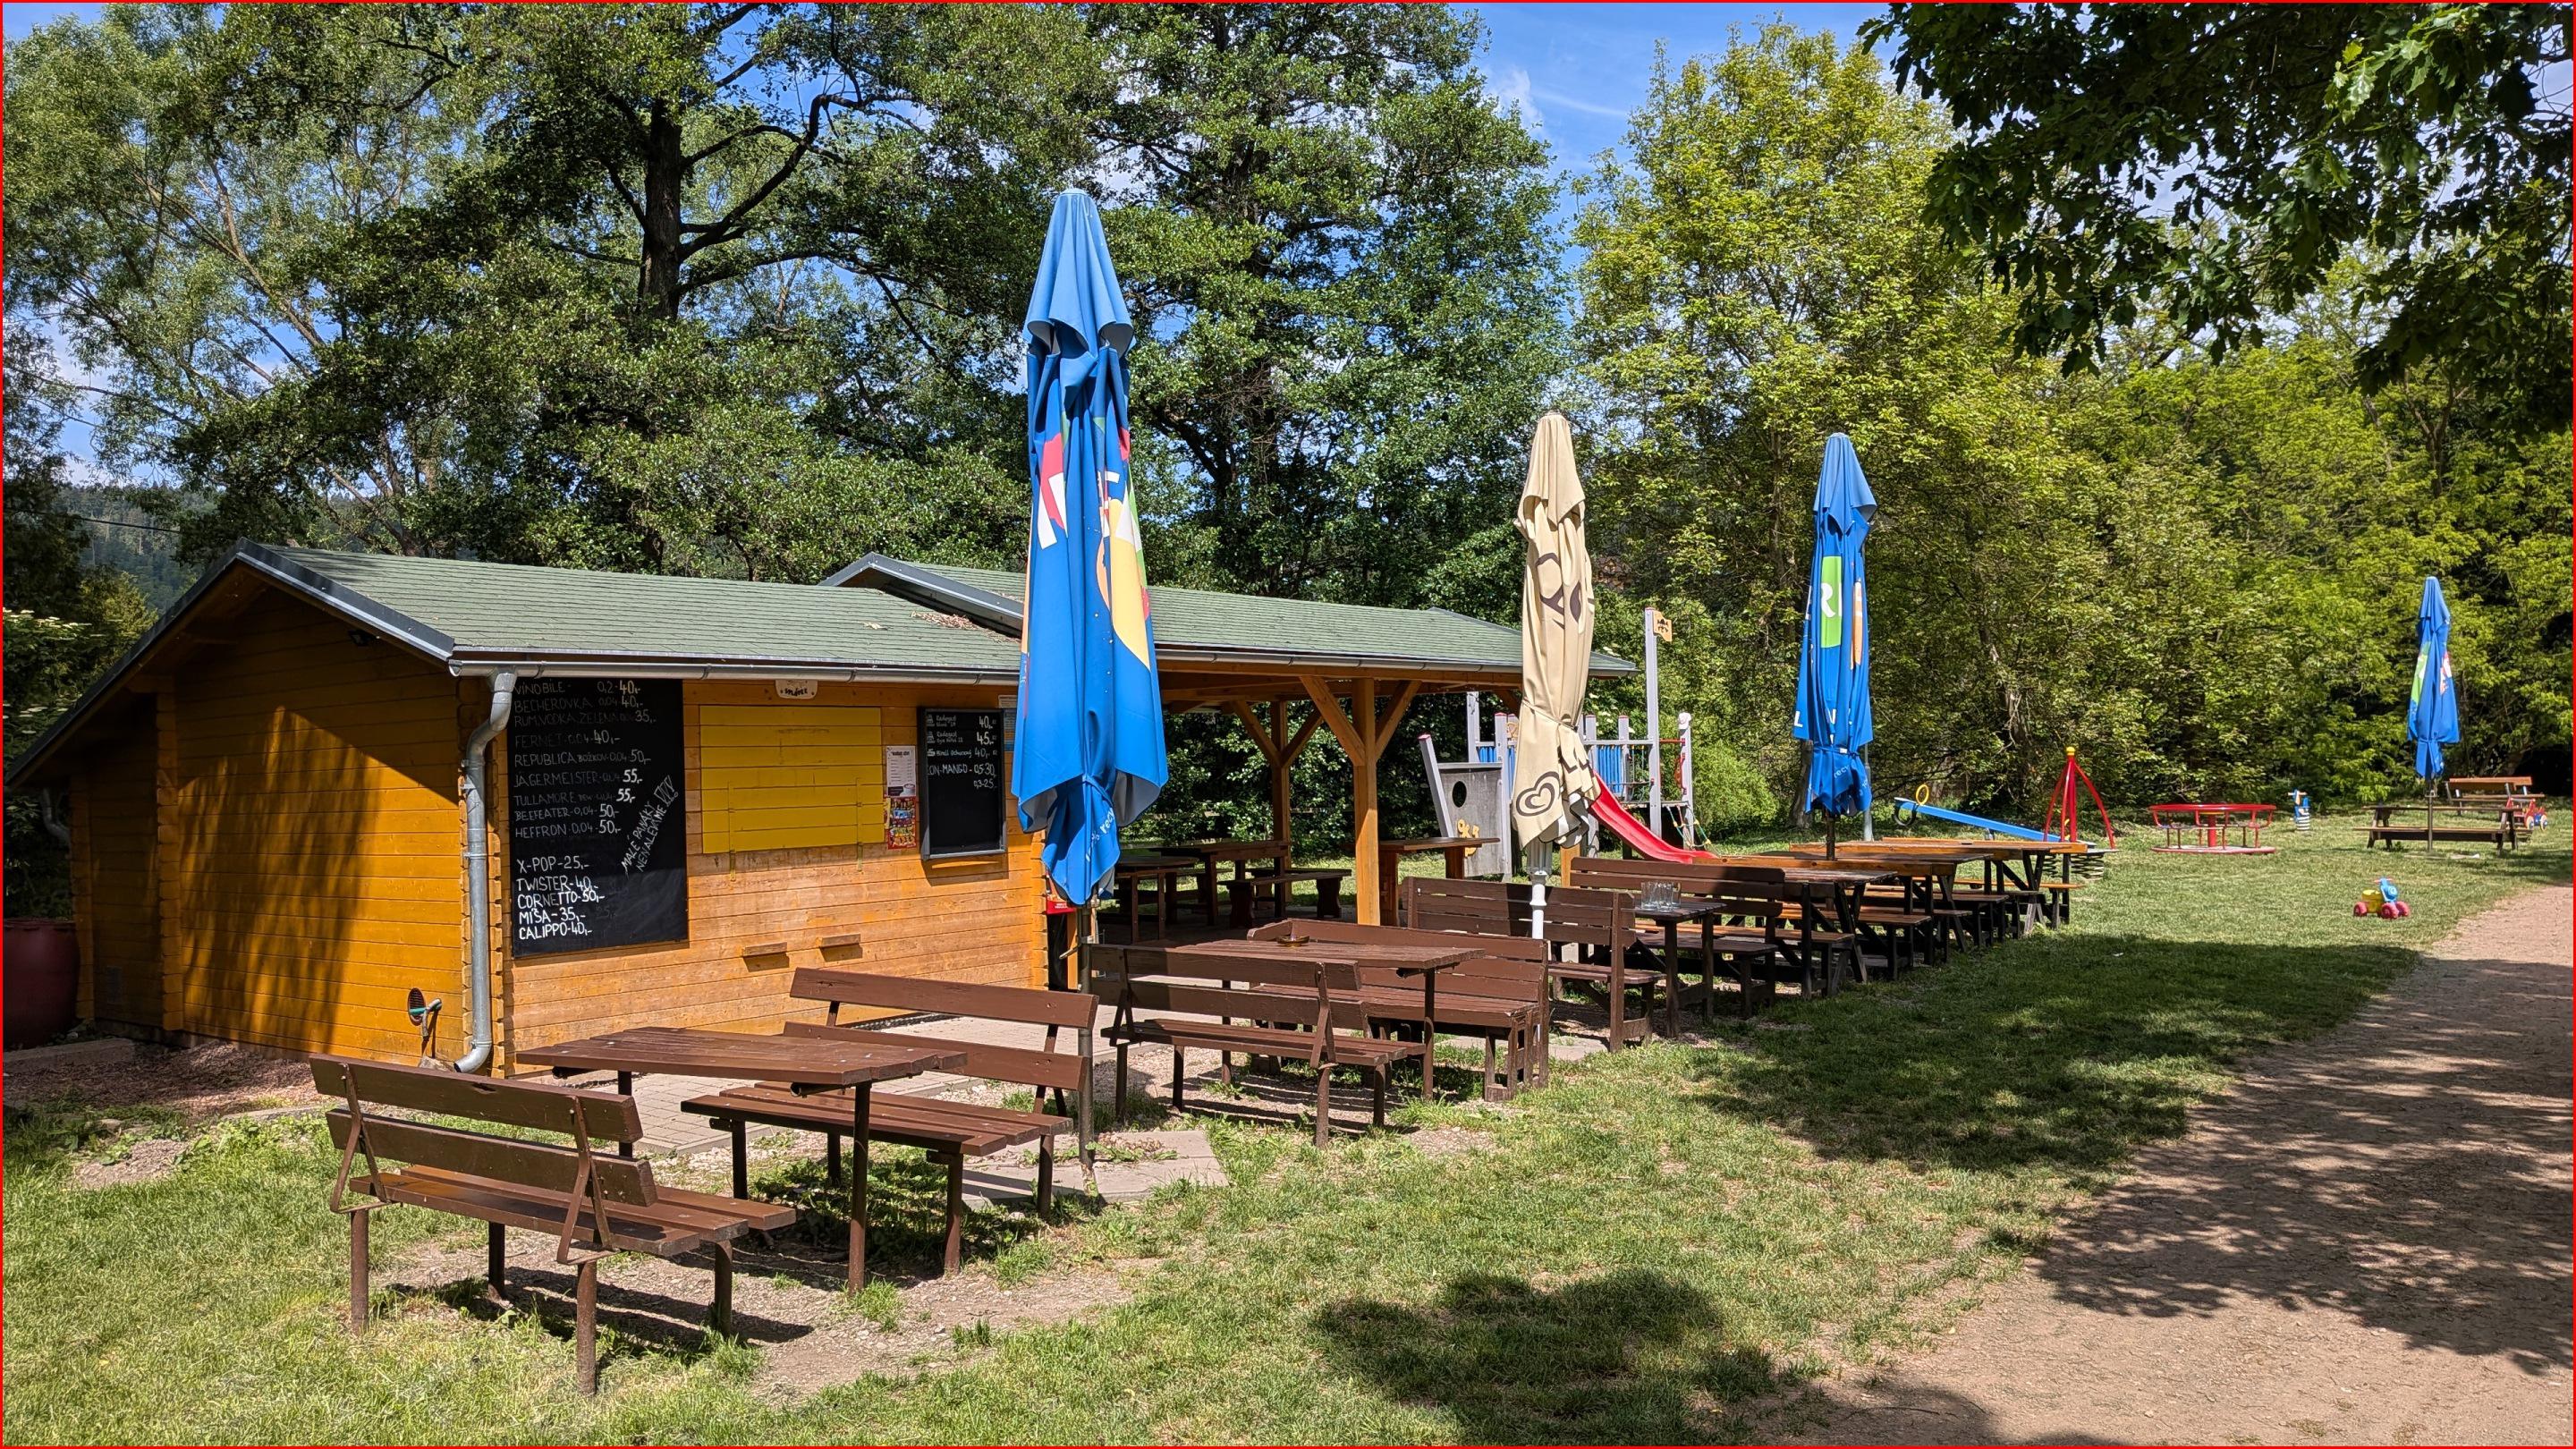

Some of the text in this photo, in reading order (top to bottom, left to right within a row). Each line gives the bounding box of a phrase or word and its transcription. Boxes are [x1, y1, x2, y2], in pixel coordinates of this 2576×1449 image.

[514, 751, 579, 768] REPUBLICA
[513, 791, 577, 807] TULLAMORE
[514, 807, 571, 822] BEEFEATER
[514, 824, 567, 839] HEFFRON
